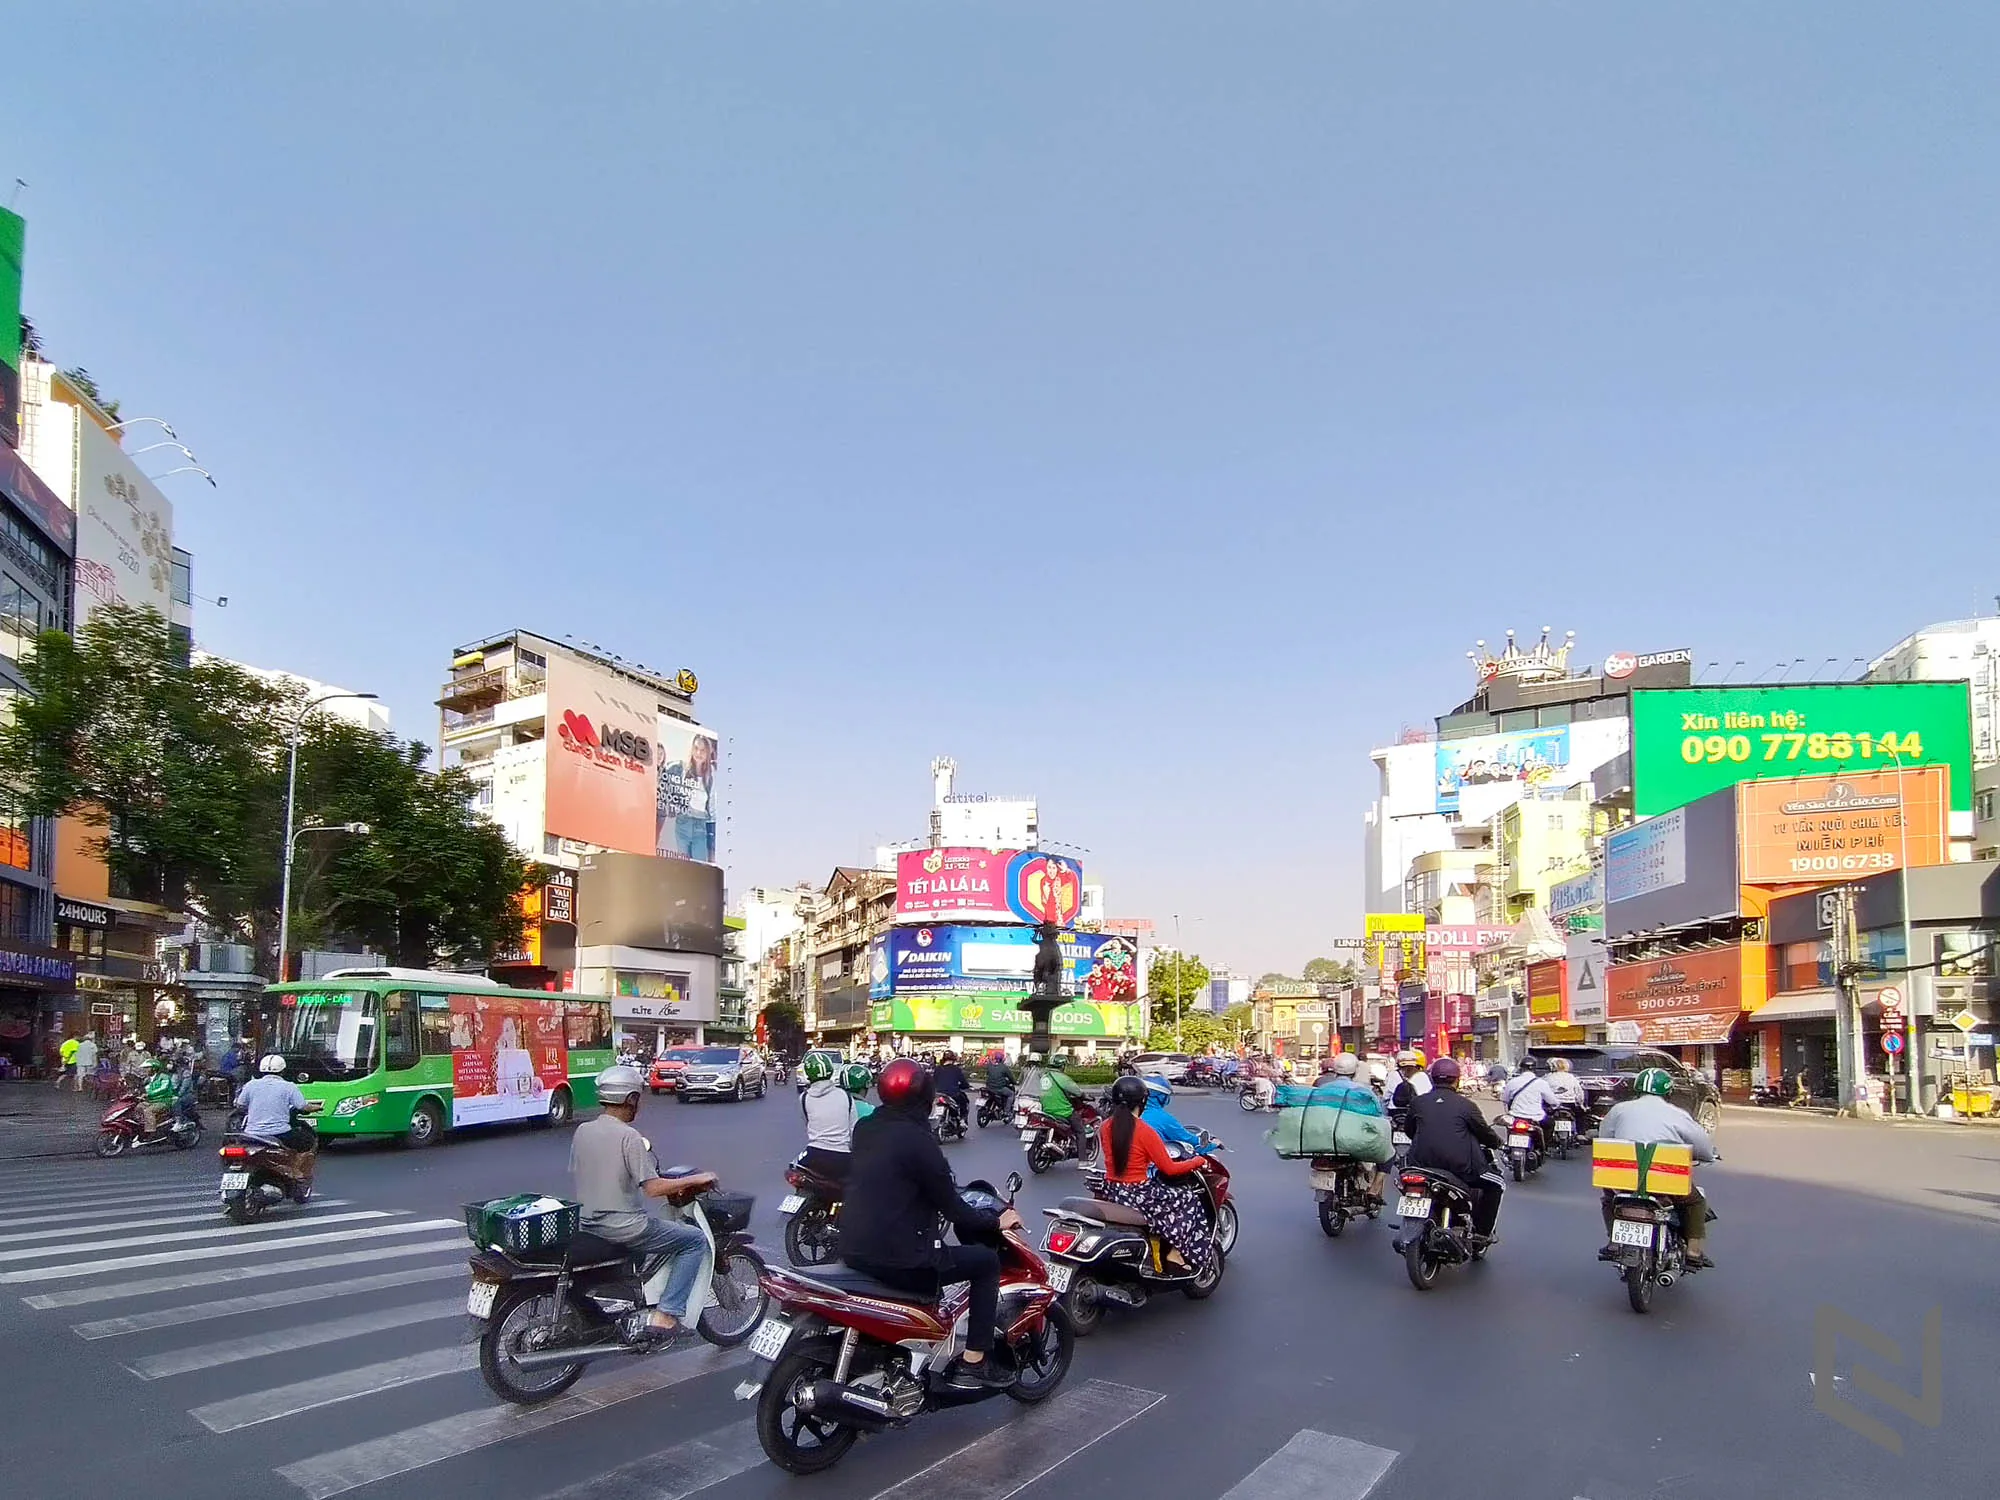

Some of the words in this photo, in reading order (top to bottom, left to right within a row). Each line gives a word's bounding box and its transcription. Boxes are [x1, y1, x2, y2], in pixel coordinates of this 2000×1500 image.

[1498, 658, 1549, 673] GARDEN
[1638, 650, 1691, 668] GARDEN
[1682, 714, 1719, 731] Xin
[1725, 712, 1765, 729] liên
[1770, 710, 1806, 731] hệ:
[601, 723, 651, 761] MSB
[1681, 734, 1751, 764] 090
[1760, 731, 1923, 761] 7788144
[1649, 815, 1680, 831] PACIFIC
[1789, 856, 1839, 873] 1900
[1842, 852, 1895, 870] 6733
[554, 888, 569, 897] VALI
[908, 877, 928, 894] TẾT
[931, 876, 948, 893] LÀ
[950, 875, 969, 892] LÁ
[971, 878, 990, 892] LA
[58, 902, 107, 925] 24HOURS
[1426, 930, 1473, 946] DOLL
[908, 952, 952, 963] DAIKIN
[1637, 998, 1665, 1011] 1900
[1667, 994, 1700, 1007] 6733
[1614, 1232, 1648, 1245] 662.40
